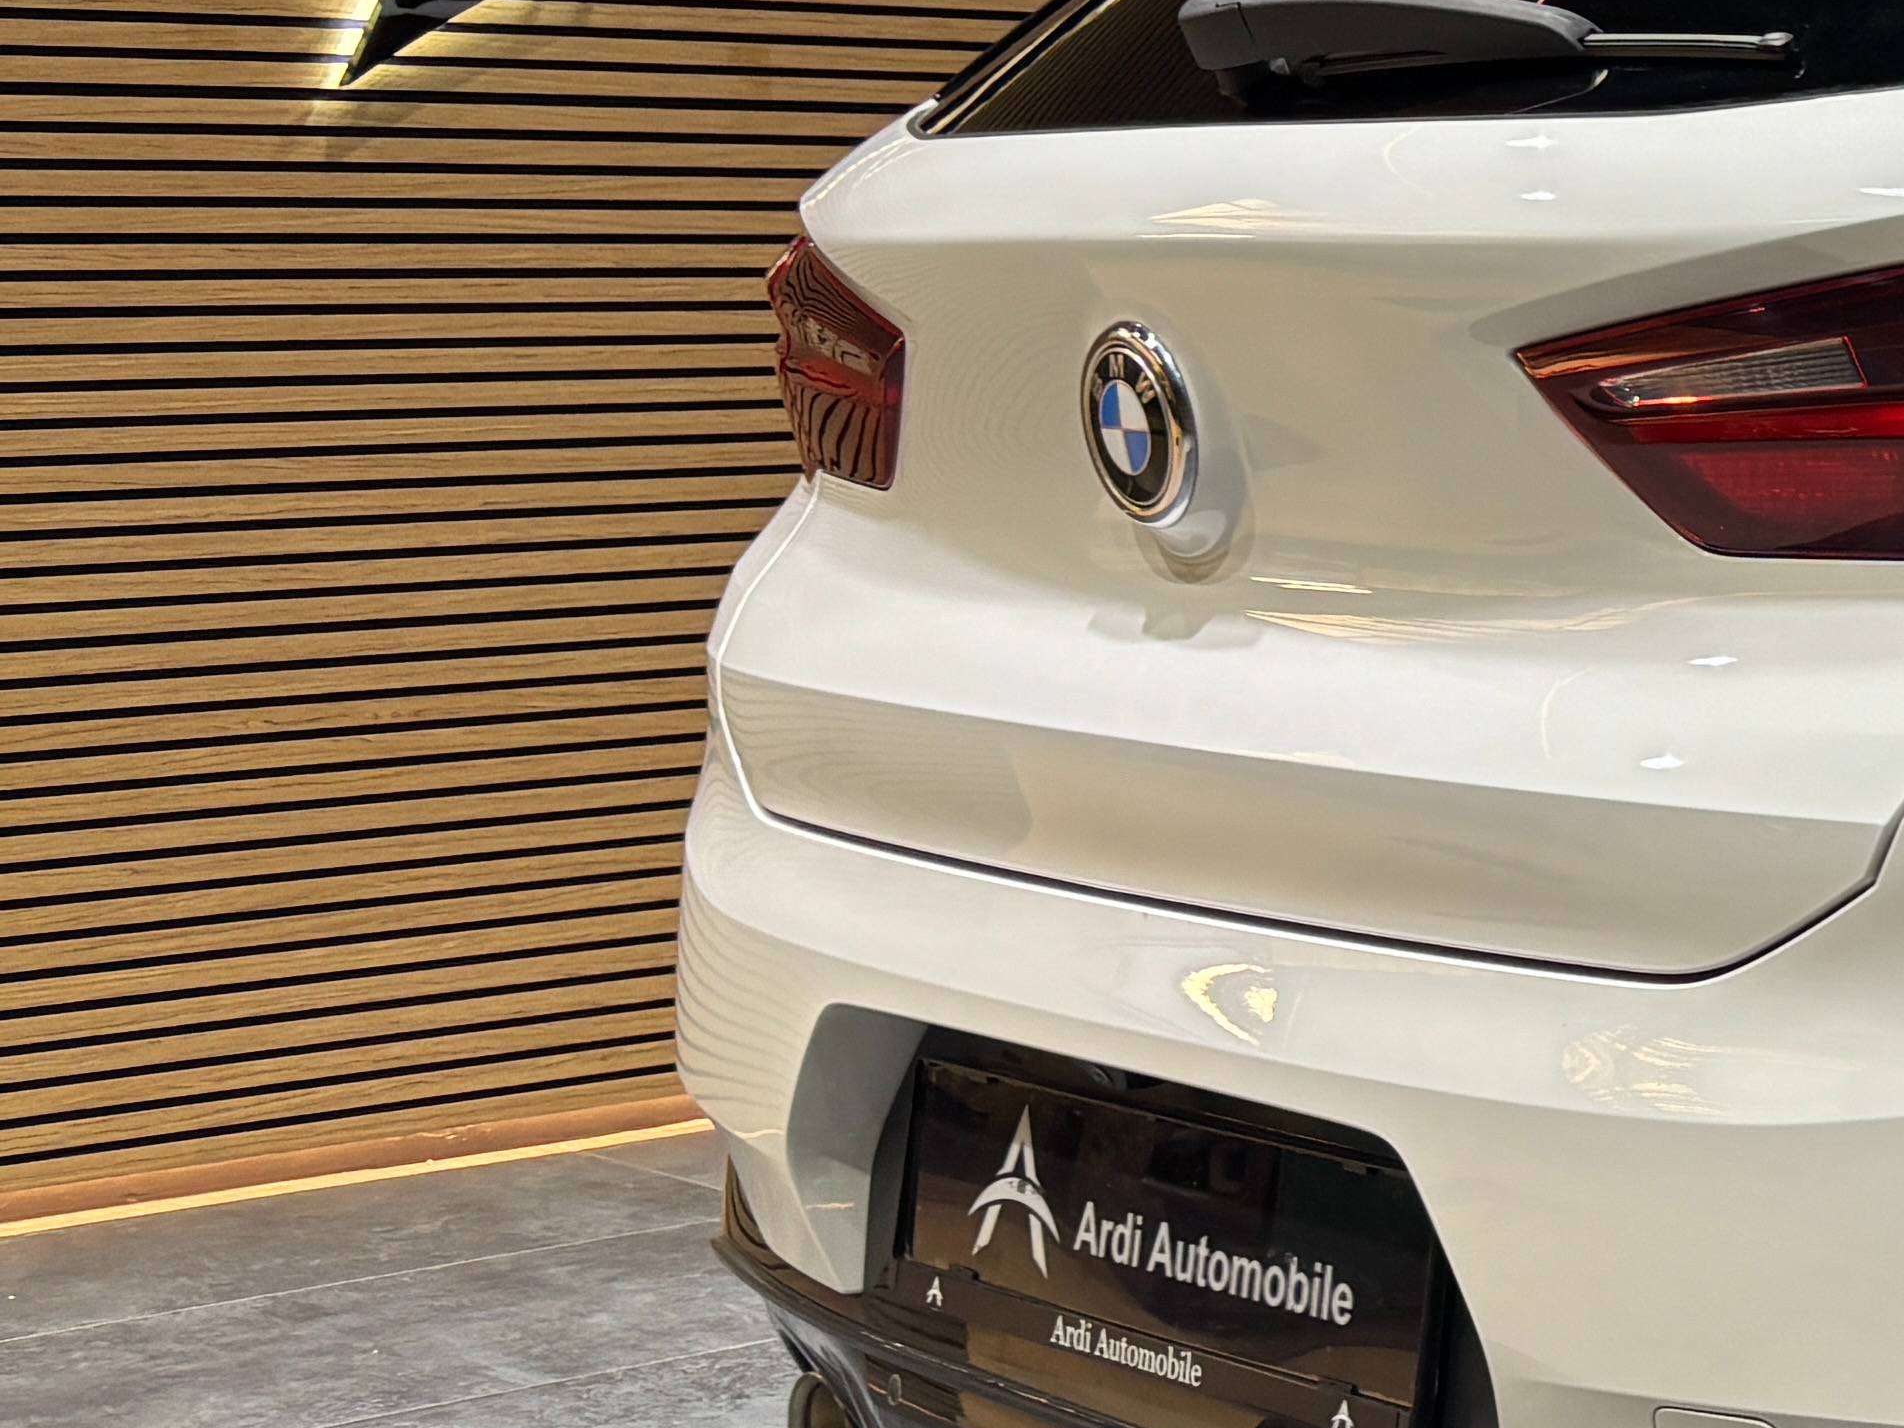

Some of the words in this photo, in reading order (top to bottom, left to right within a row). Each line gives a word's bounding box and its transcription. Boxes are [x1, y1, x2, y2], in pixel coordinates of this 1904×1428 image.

[1073, 1201, 1143, 1268] Ardi
[1146, 1222, 1354, 1326] Automobile
[1050, 1315, 1093, 1353] Ardi
[1095, 1328, 1202, 1387] Automobile
